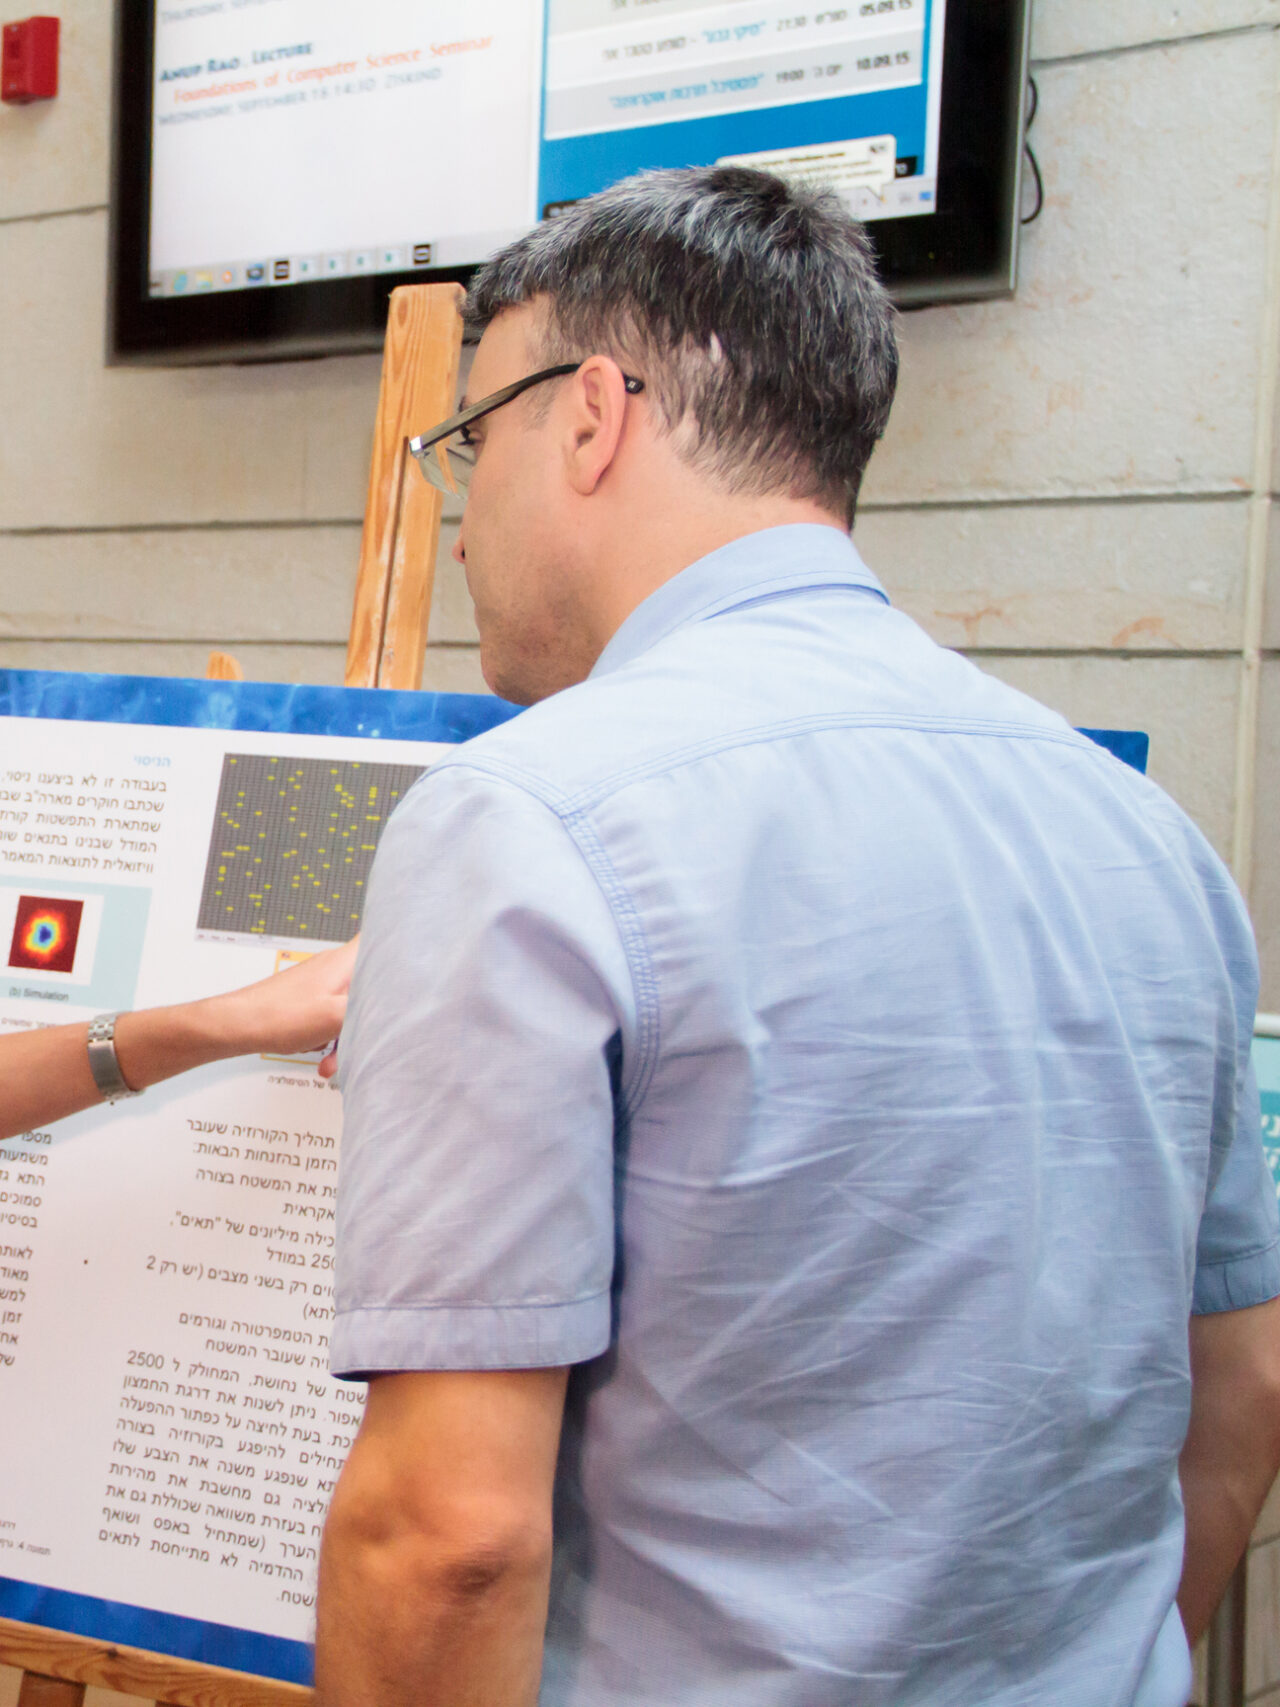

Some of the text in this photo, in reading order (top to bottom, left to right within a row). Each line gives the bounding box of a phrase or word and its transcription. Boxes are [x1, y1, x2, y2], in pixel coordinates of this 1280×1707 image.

[174, 79, 256, 103] Foundations
[287, 61, 357, 83] Computer
[366, 49, 421, 69] Science
[430, 35, 494, 58] Seminar
[134, 756, 171, 766] הניסוי
[37, 772, 74, 786] ביצענו
[80, 773, 97, 787] לא
[103, 777, 115, 787] זו
[120, 778, 167, 793] בעבודה
[76, 795, 119, 810] חוקרים
[122, 799, 165, 813] שכתבו
[35, 812, 96, 828] התפשטות
[103, 817, 161, 833] שמתארת
[23, 831, 68, 846] בתנאים
[74, 836, 113, 850] שבנינו
[119, 837, 157, 853] המודל
[1, 850, 44, 864] המאמר
[47, 854, 99, 868] לתוצאות
[102, 857, 154, 873] וויזואלית
[23, 988, 70, 1002] Simulation
[186, 1119, 335, 1149] תהליך הקורוזיה שעובר
[304, 1156, 337, 1172] הזמן
[0, 1191, 42, 1208] סמוכים
[282, 1202, 336, 1222] אקראית
[224, 1217, 245, 1235] של
[248, 1224, 300, 1243] מיליונים
[0, 1265, 29, 1282] מאוד
[145, 1254, 308, 1295] רק בשני מצבים (יש רק 2
[1, 1310, 24, 1325] זמן
[126, 1350, 327, 1398] של המחולק ל 2500
[122, 1375, 316, 1420] ניתן לשנות את דרגת החמצון
[119, 1395, 321, 1444] בעת לחיצה על כפתור ההפעלה
[115, 1417, 286, 1459] להיפגע בקורוזיה בצורה
[112, 1438, 309, 1488] שנפגע משנה את הצבע שלו
[108, 1462, 281, 1506] גם מחשבת את מהירות
[104, 1484, 306, 1536] בעזרת משוואה שכוללת גם את
[101, 1506, 317, 1562] הערך (שמתחיל באפס ושואף
[97, 1528, 304, 1582] ההדמיה לא מתייחסת לתאים
